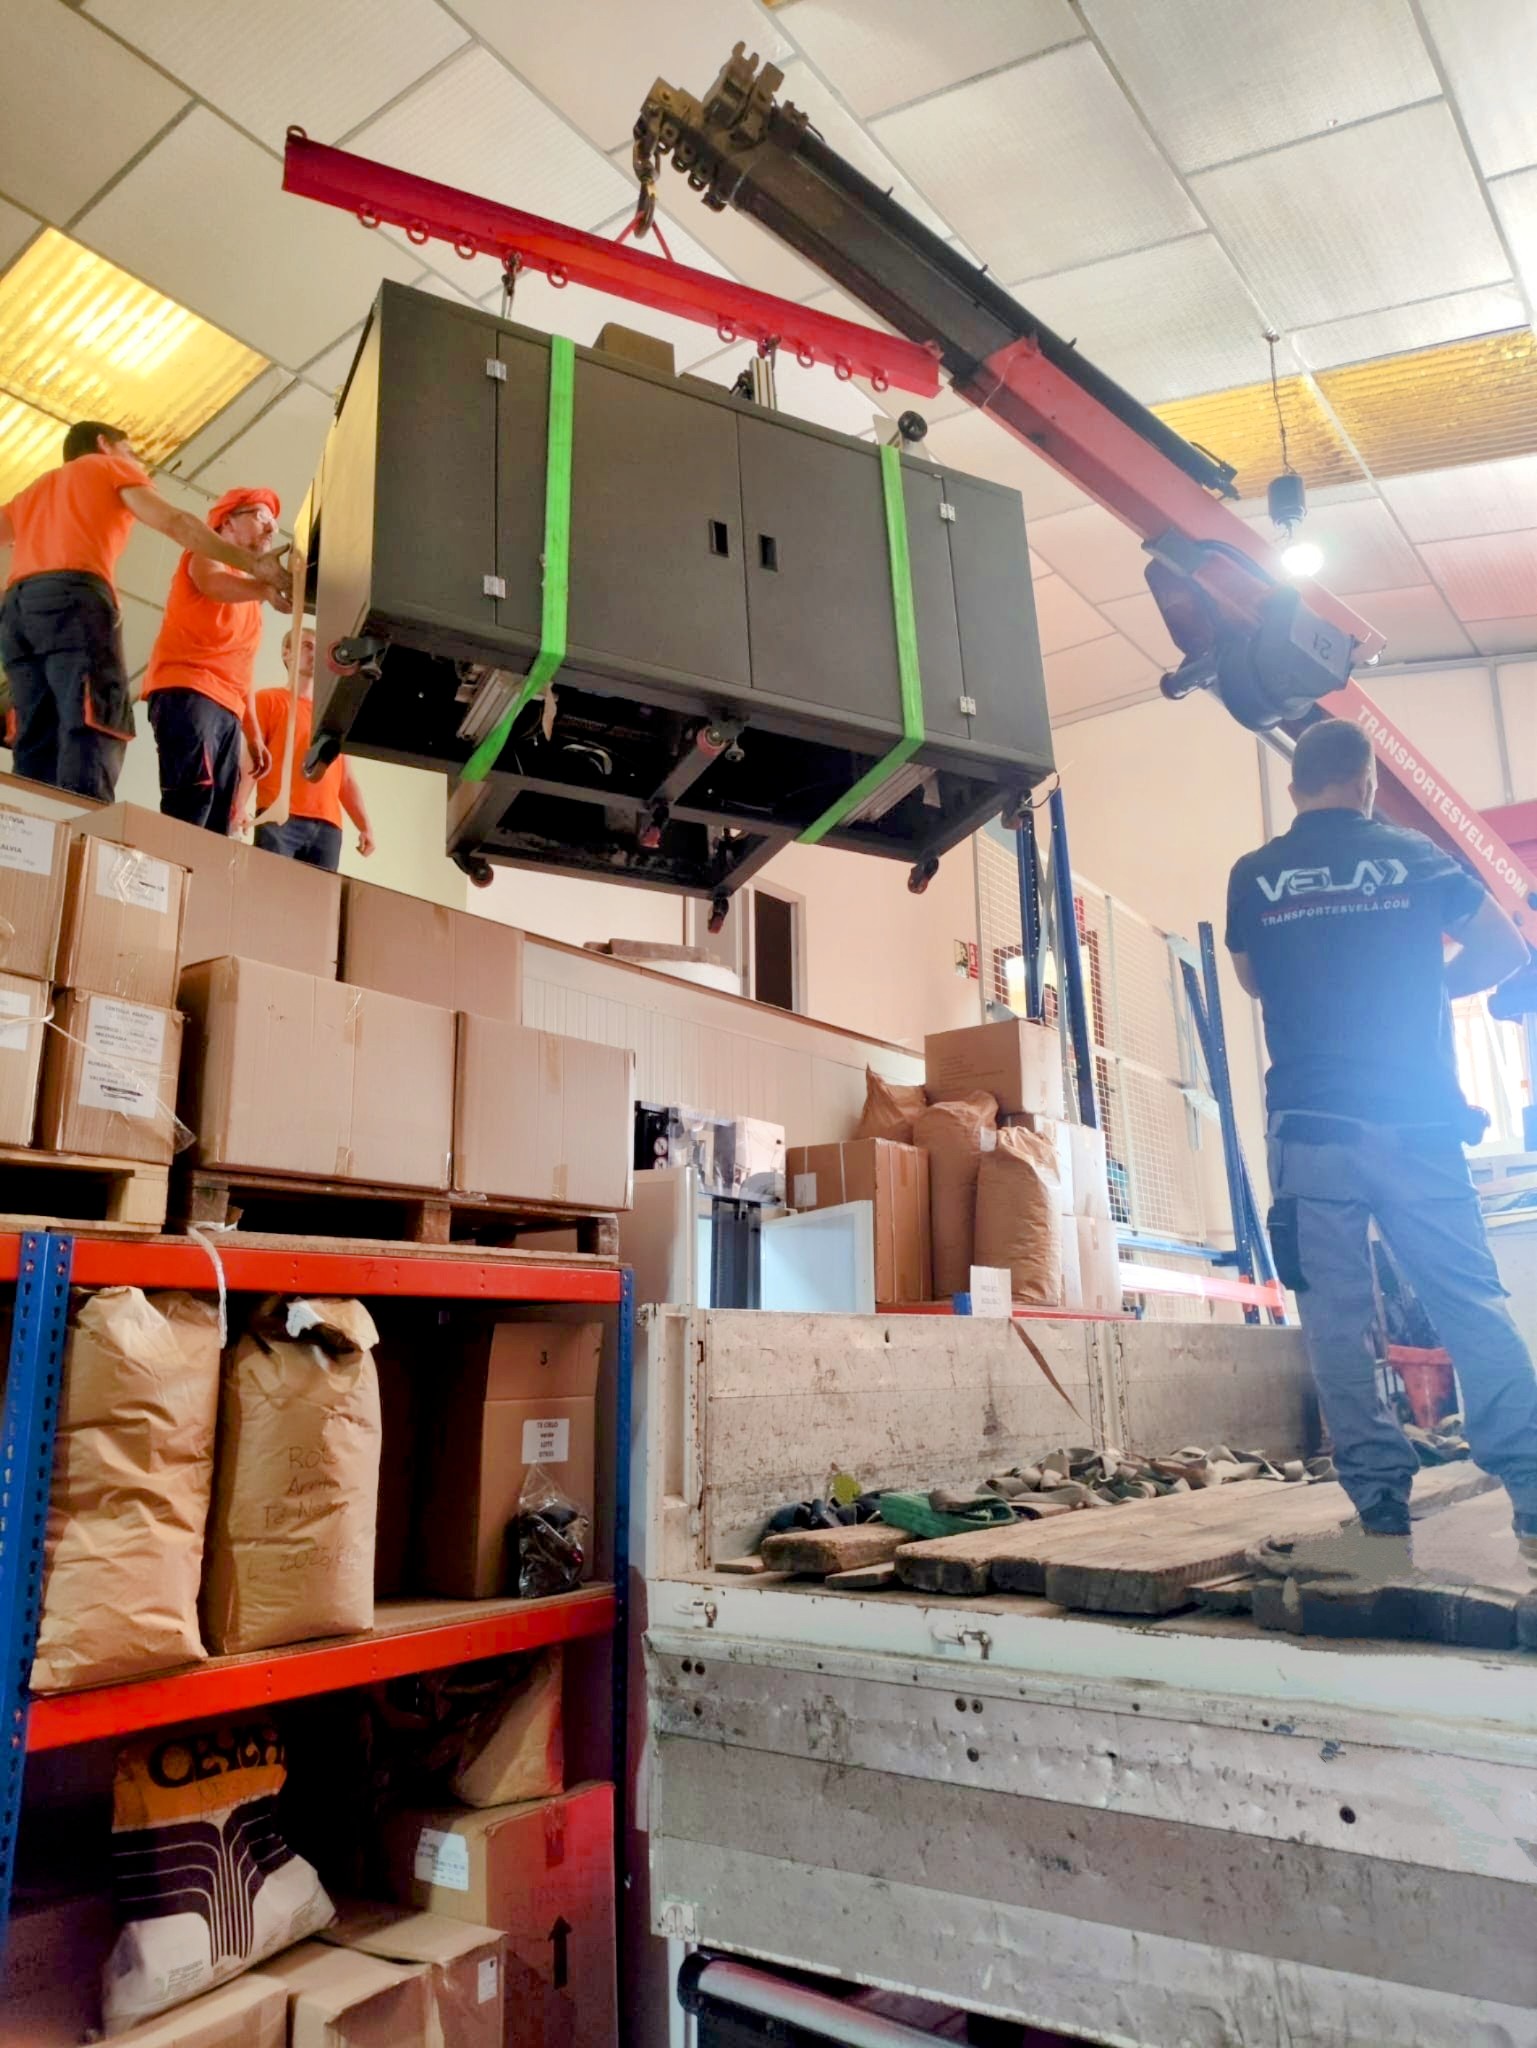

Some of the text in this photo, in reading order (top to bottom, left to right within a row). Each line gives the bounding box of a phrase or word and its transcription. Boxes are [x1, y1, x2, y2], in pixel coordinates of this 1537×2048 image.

[1357, 705, 1529, 898] TRANSPORTESVELA.COM
[1256, 859, 1388, 902] VELA
[1261, 900, 1410, 926] TRANSPORTESVELA.COM
